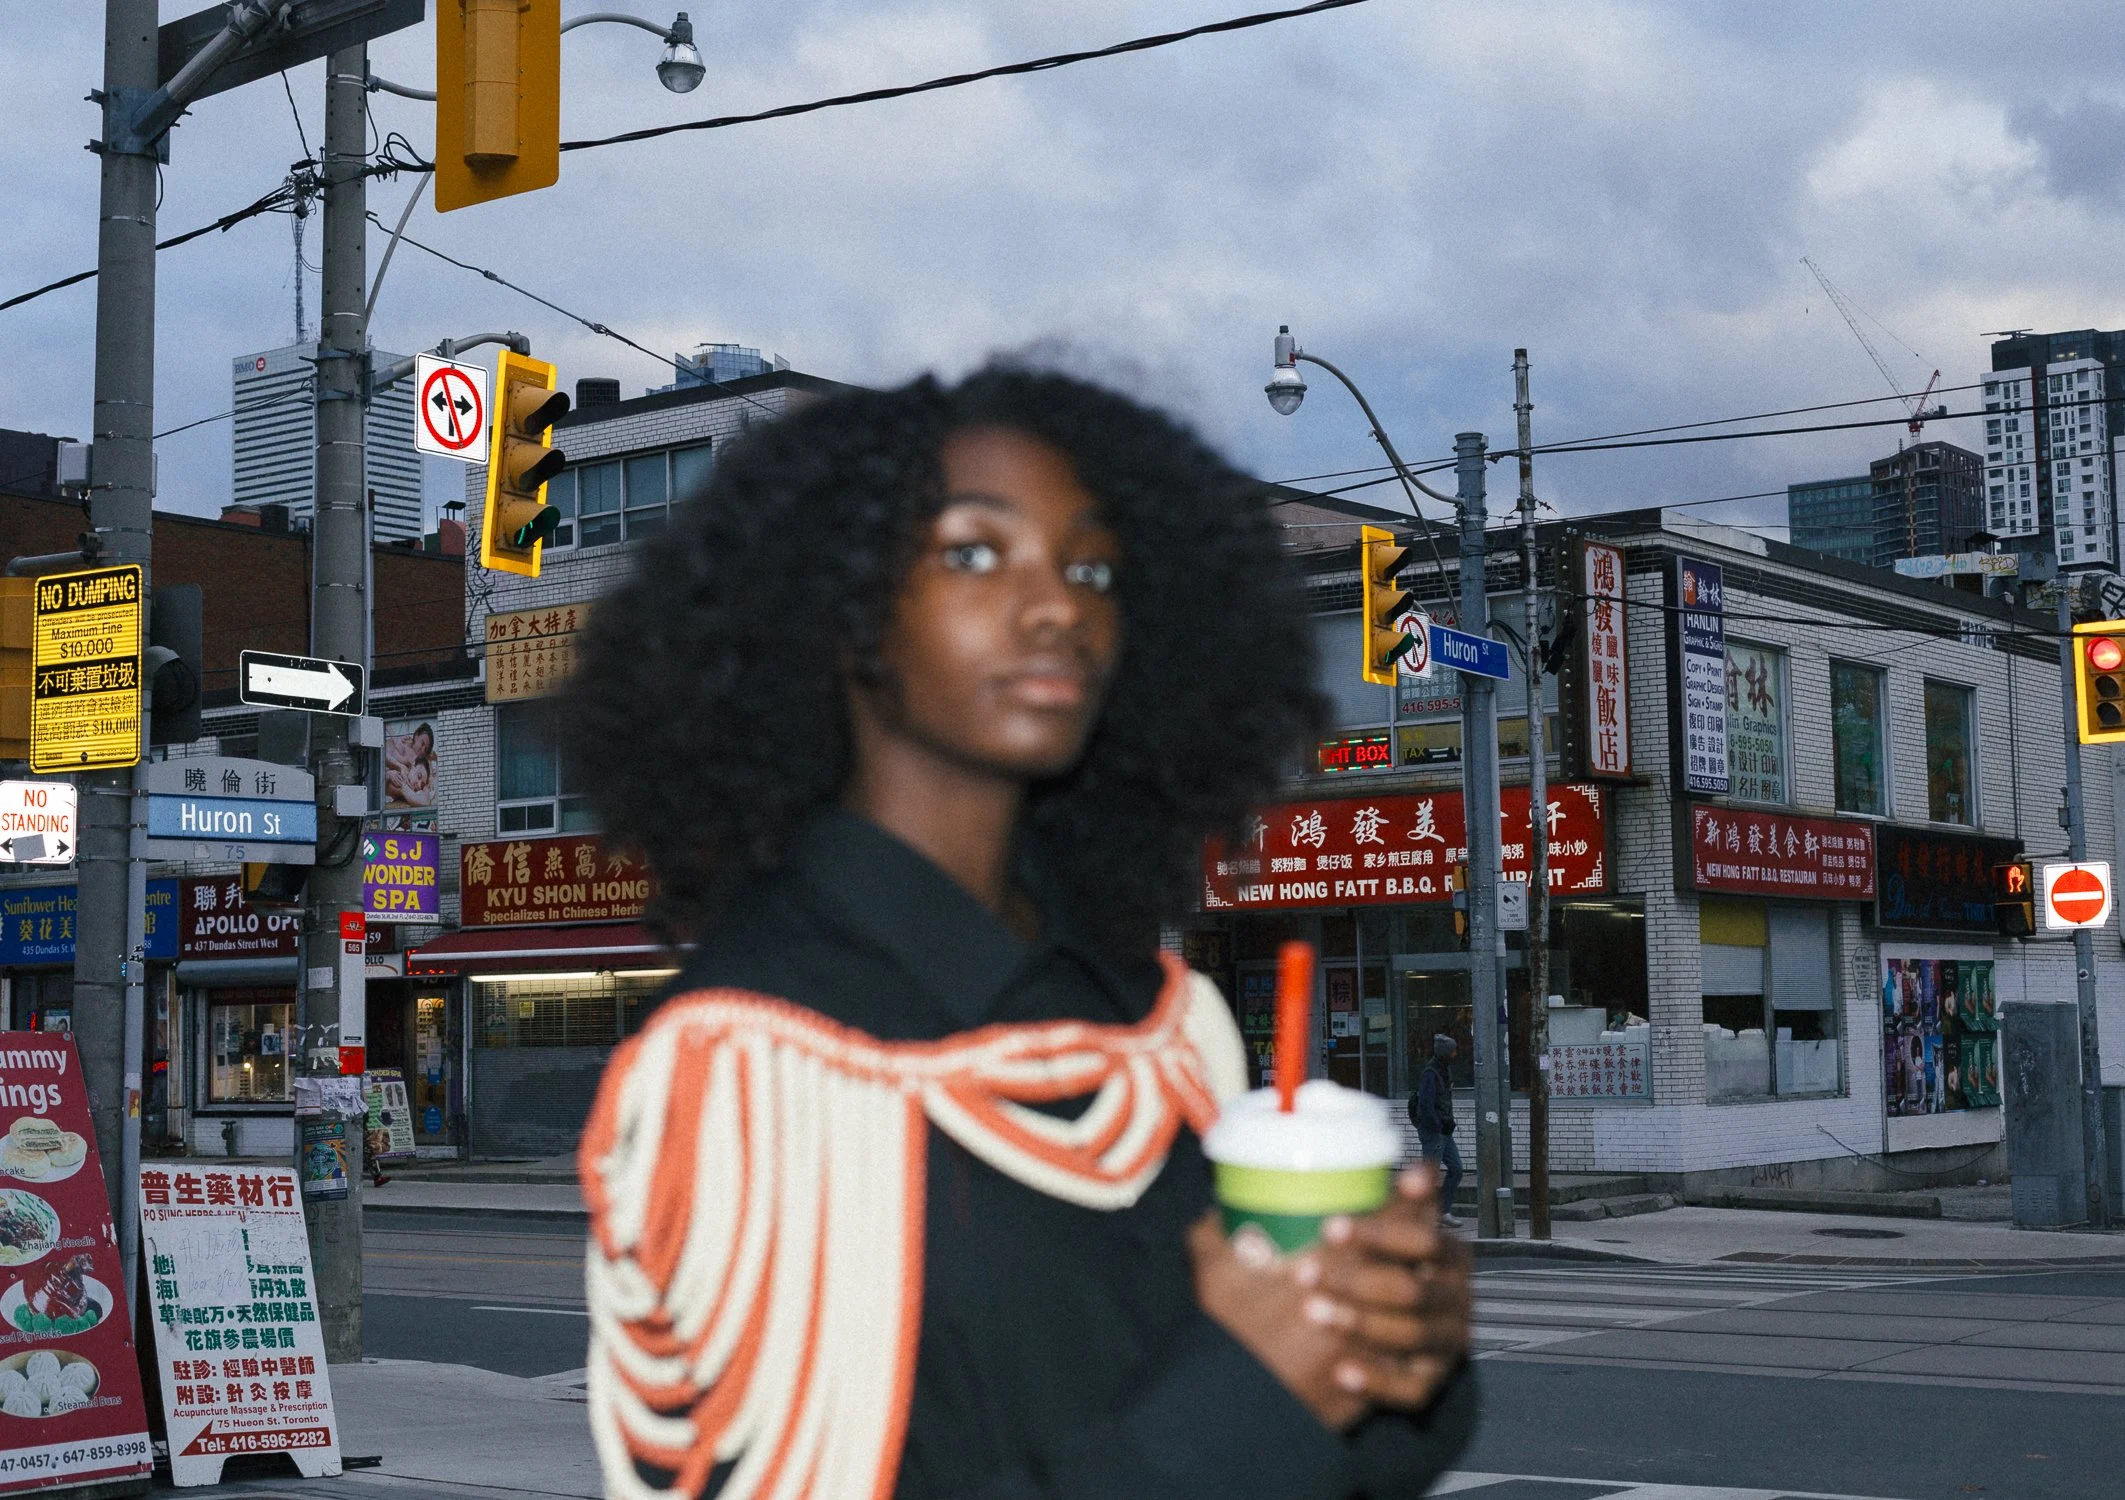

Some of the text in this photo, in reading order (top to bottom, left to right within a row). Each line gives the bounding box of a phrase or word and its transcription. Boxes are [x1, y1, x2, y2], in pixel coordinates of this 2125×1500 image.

[235, 361, 254, 373] BMO
[41, 574, 135, 610] NO DUMPING
[51, 622, 123, 640] Maximum Fine
[1686, 613, 1718, 632] HANLIN
[60, 637, 114, 659] $10,000
[1443, 633, 1489, 664] Huron St
[38, 662, 135, 694] 不可棄置垃圾
[1402, 701, 1424, 713] 416
[92, 717, 136, 736] $10,000
[1596, 685, 1618, 771] 飯店
[1743, 716, 1777, 736] Graphics
[1355, 744, 1389, 763] BOX
[1404, 748, 1425, 758] TAX
[24, 789, 47, 808] NO
[1, 812, 69, 833] STANDING
[181, 803, 282, 835] Huron St
[225, 845, 245, 860] 75
[384, 839, 422, 860] S.J
[1707, 863, 1721, 877] NEW
[1722, 865, 1740, 879] HONG
[1742, 866, 1760, 881] FATT
[487, 880, 649, 907] KYU SHON HONG
[1238, 876, 1437, 902] NEW HONG FATT B.B.Q.
[4, 895, 55, 915] Sunflower
[373, 889, 420, 910] SPA
[483, 908, 545, 924] Specializes
[549, 907, 560, 920] In
[563, 904, 608, 919] Chinese
[195, 913, 259, 935] APOLLO
[35, 944, 60, 955] Dundas
[195, 937, 278, 952] 437 Dundas Street West
[347, 943, 360, 952] 505
[141, 1171, 294, 1207] 普生藥材行
[144, 1209, 155, 1221] PO
[21, 1239, 62, 1250] Zhajiang
[17, 1332, 33, 1343] Pig
[34, 1329, 62, 1341] Hocks
[58, 1396, 122, 1411] Steamed Buns
[173, 1401, 328, 1418] Acupuncture Massage & Prescription
[217, 1419, 229, 1428] 75
[267, 1417, 280, 1425] St.
[283, 1416, 319, 1425] Toronto
[196, 1430, 325, 1453] Tel: 416-596-2282
[62, 1440, 147, 1464] 647-859-8998
